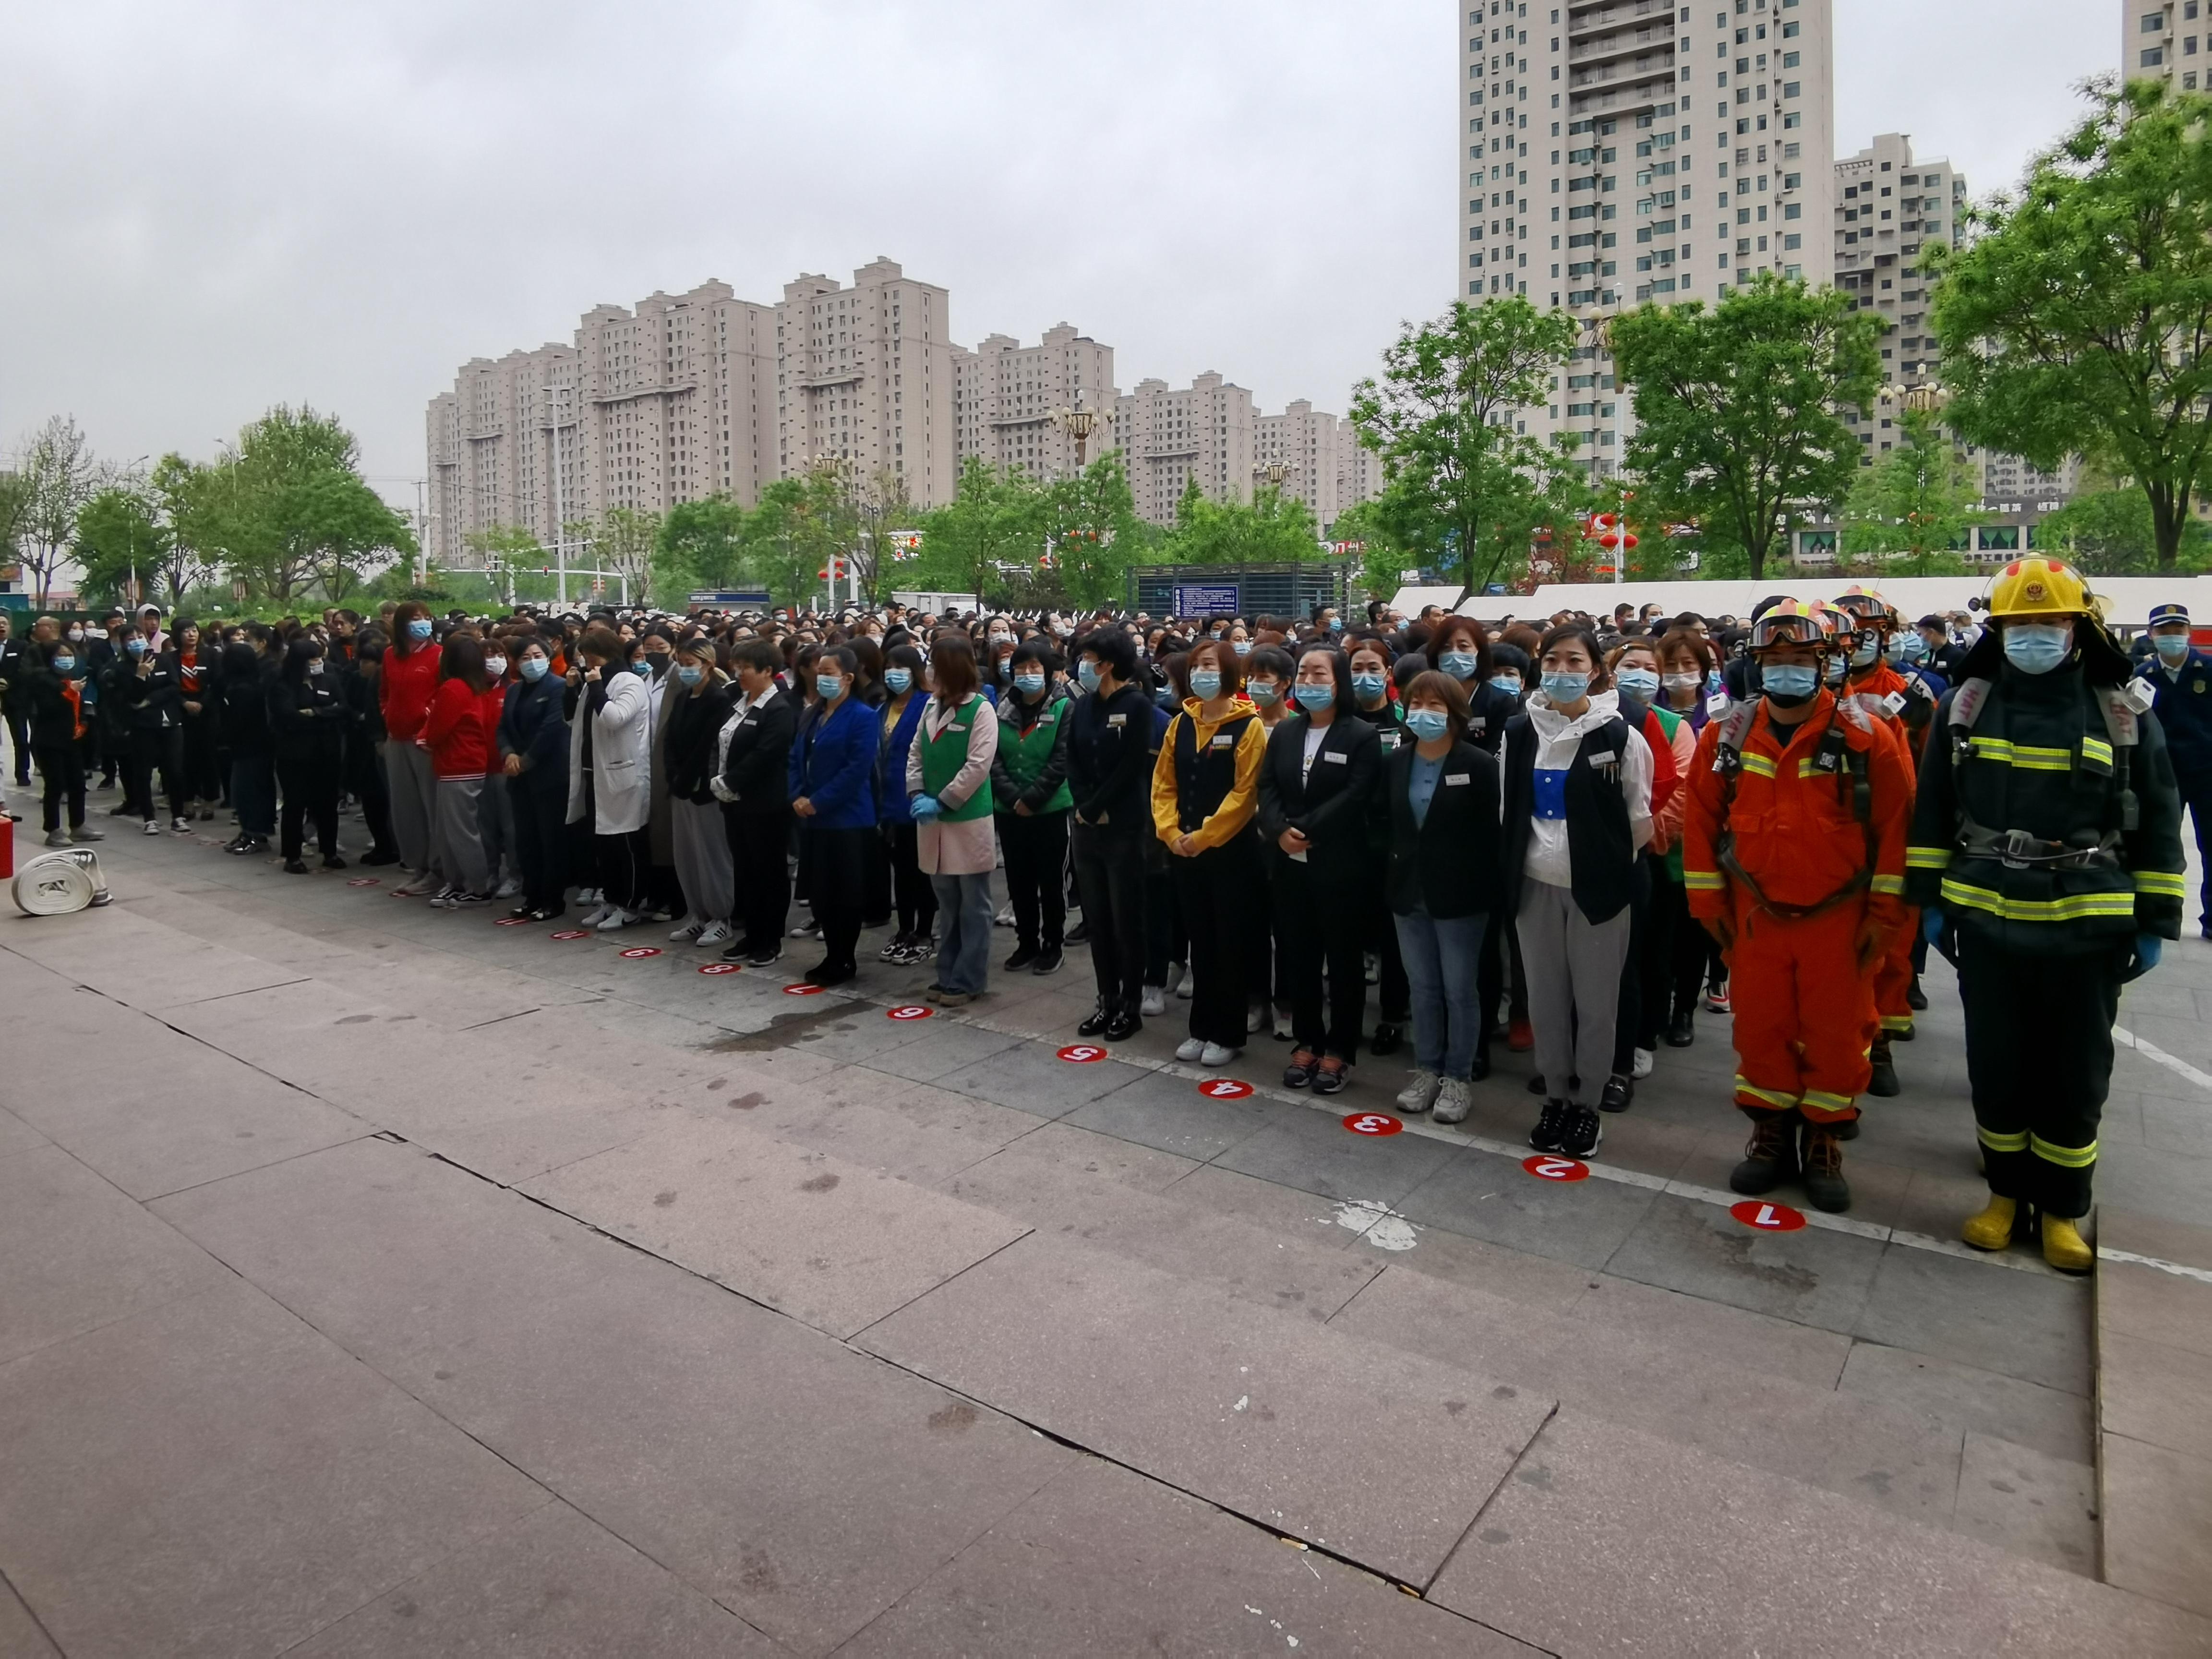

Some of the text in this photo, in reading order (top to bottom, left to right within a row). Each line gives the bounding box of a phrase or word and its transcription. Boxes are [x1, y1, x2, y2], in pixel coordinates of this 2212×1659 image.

[1958, 688, 1979, 720] HAT
[1725, 711, 1744, 740] HAT
[704, 965, 733, 973] 8
[894, 1008, 924, 1018] 6
[1064, 1047, 1098, 1060] 5
[1210, 1082, 1242, 1095] 4
[1354, 1116, 1389, 1132] 3
[1536, 1157, 1575, 1177] 2
